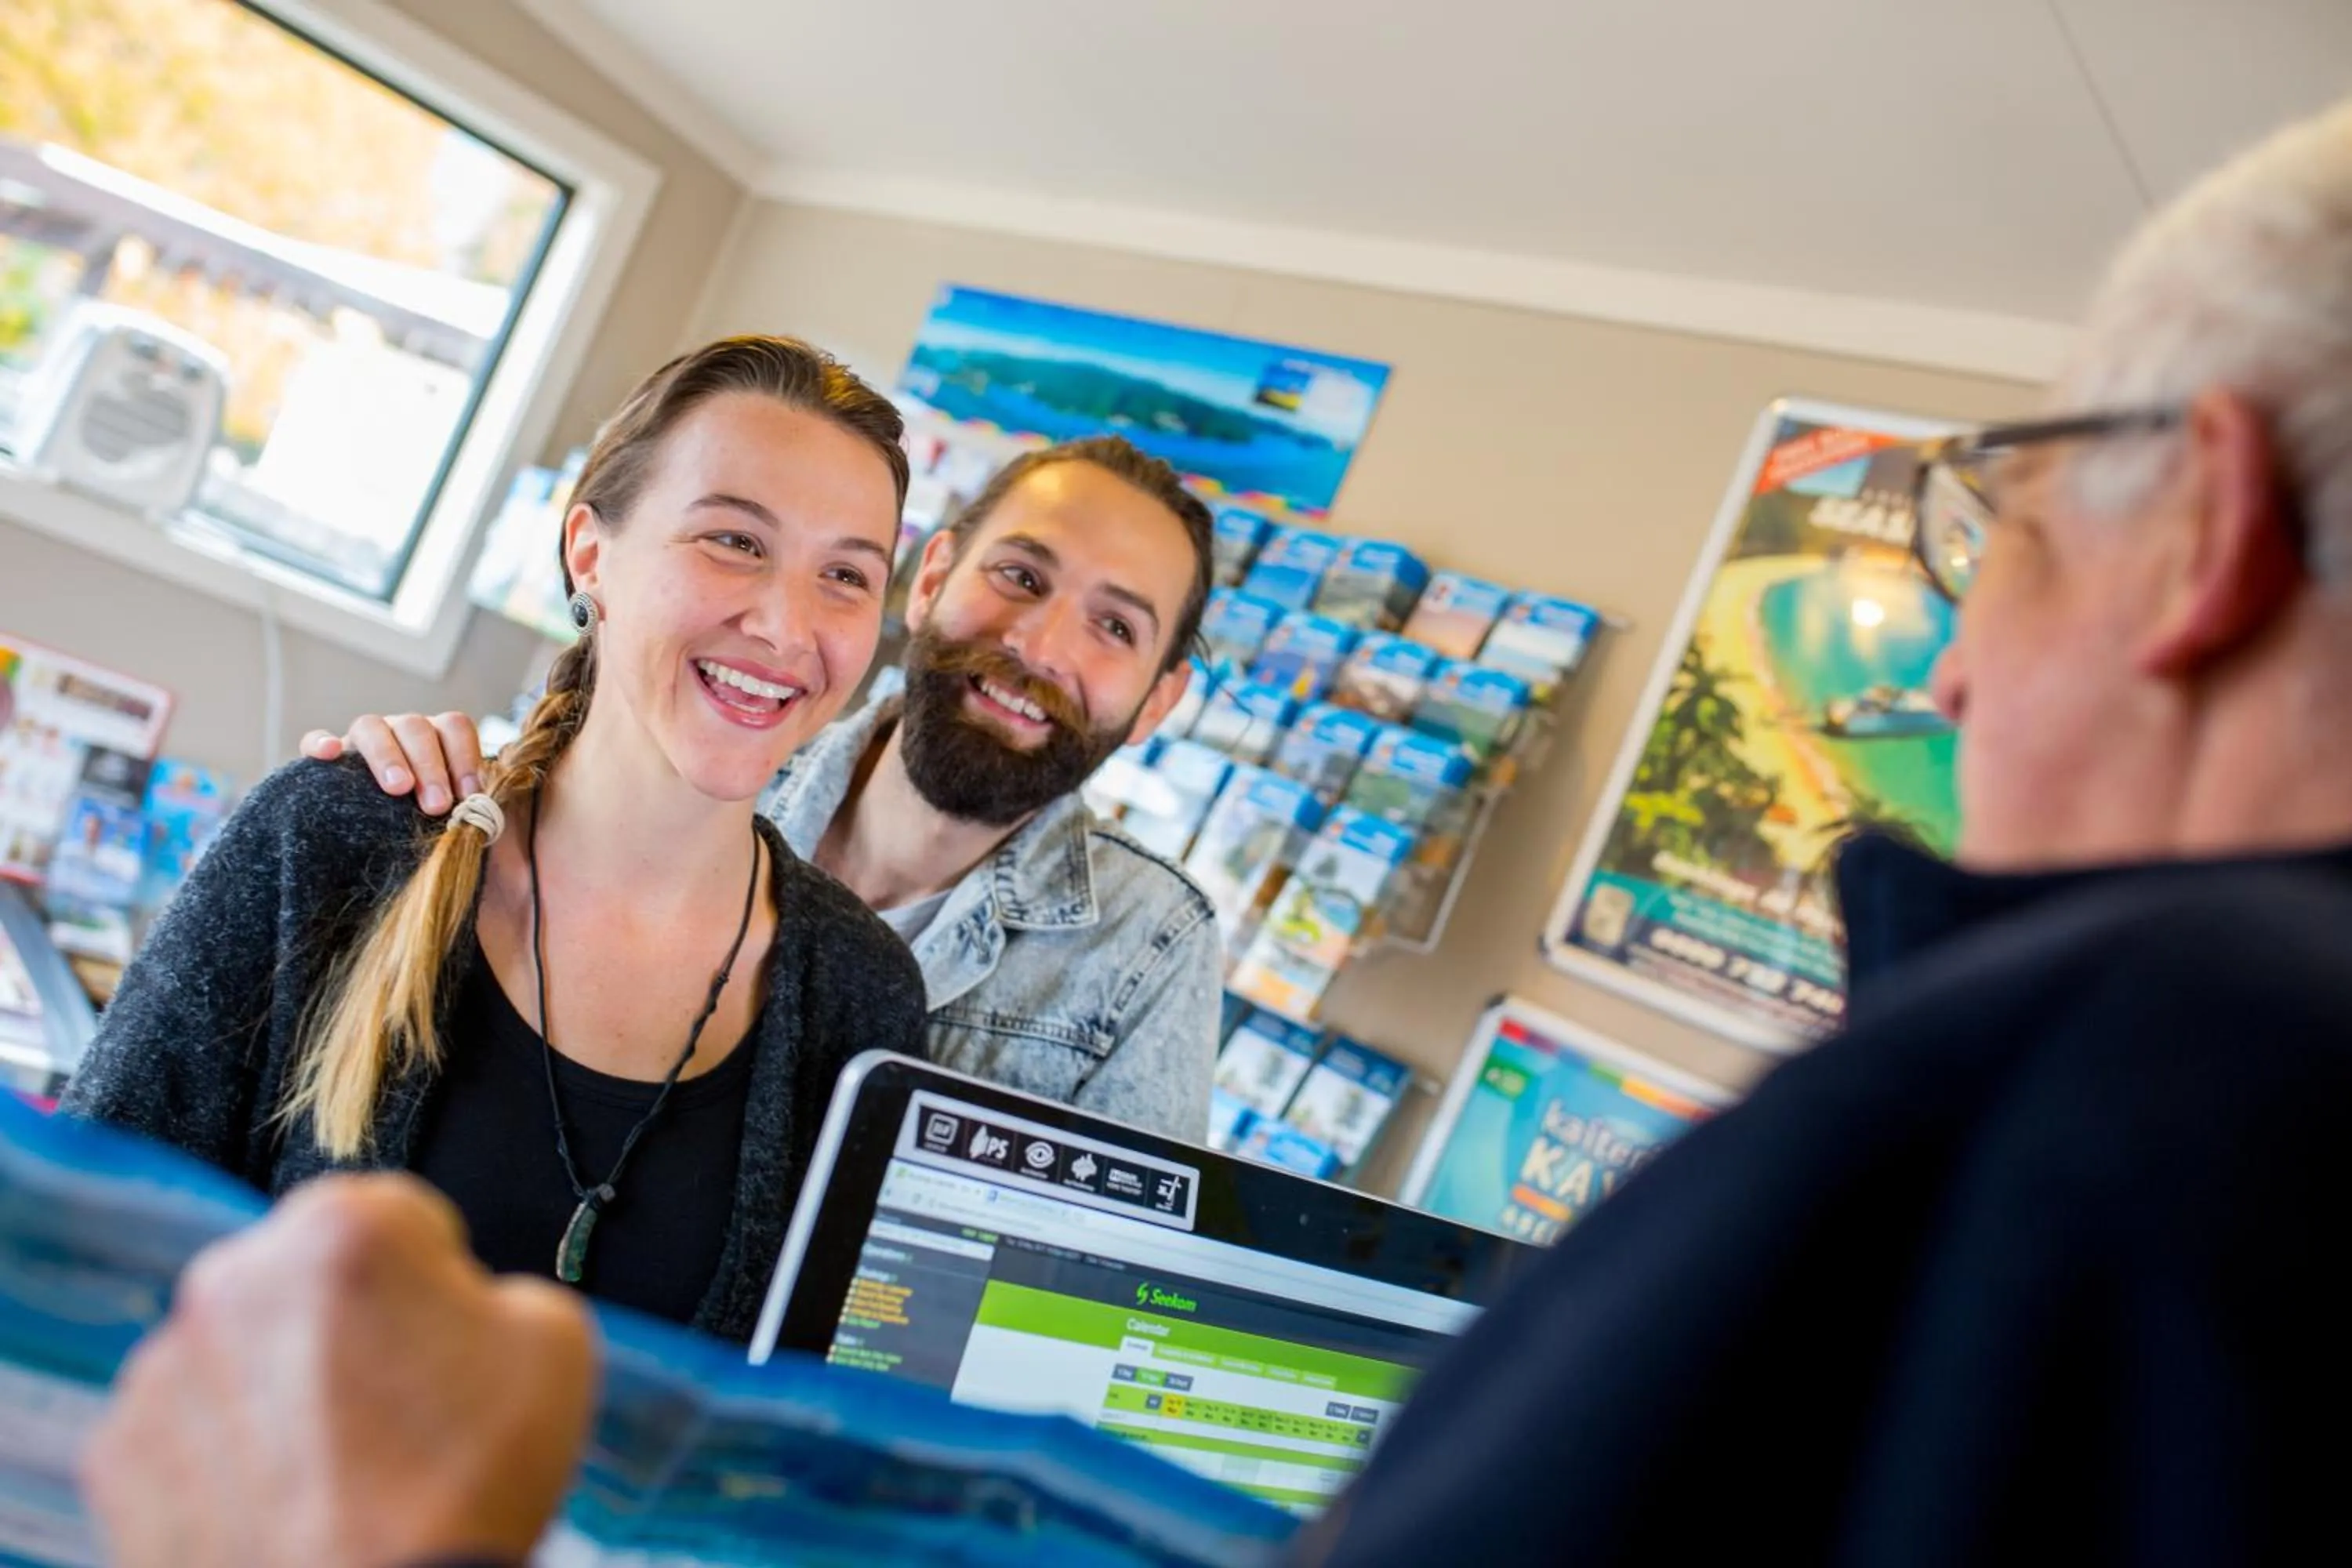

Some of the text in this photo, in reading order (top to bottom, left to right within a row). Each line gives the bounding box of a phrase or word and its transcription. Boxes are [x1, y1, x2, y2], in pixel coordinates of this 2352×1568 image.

[1544, 1099, 1661, 1171] kaiter
[1521, 1137, 1615, 1205] KA
[1150, 1288, 1196, 1313] Seekom
[1127, 1317, 1171, 1337] Calendar
